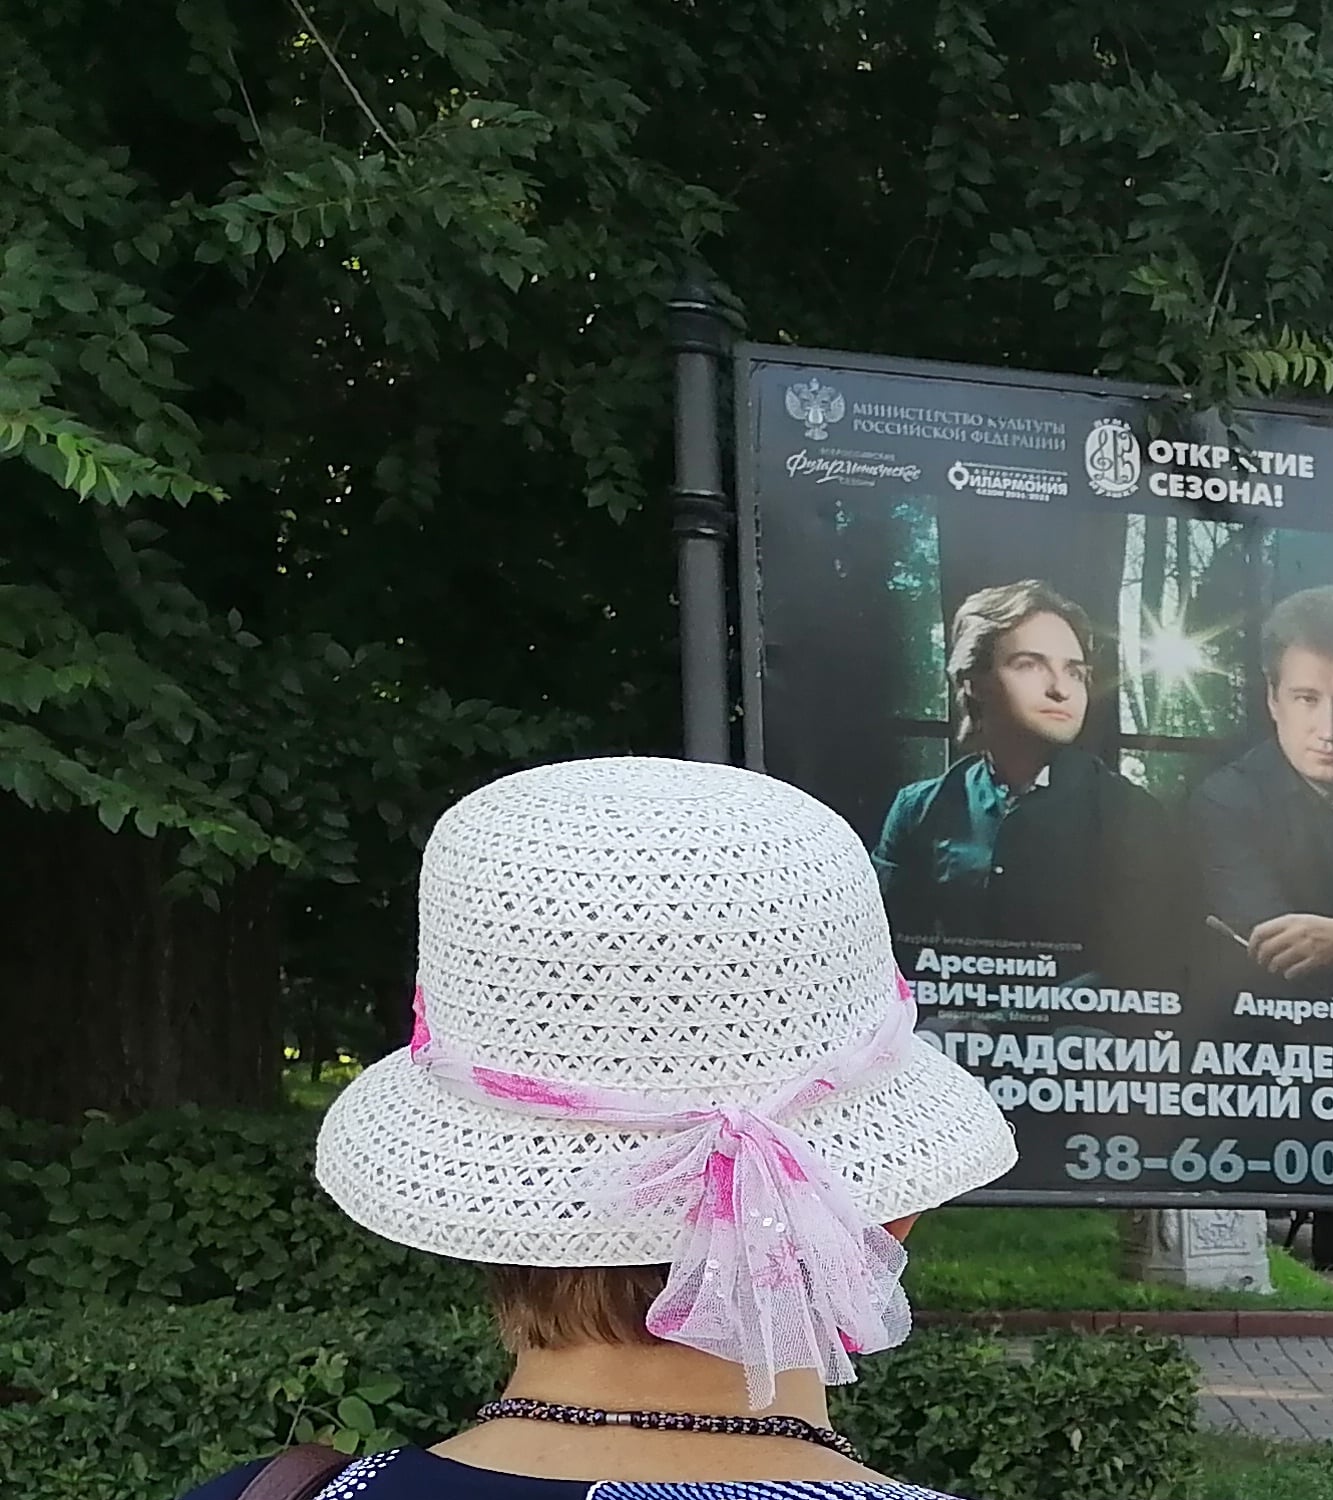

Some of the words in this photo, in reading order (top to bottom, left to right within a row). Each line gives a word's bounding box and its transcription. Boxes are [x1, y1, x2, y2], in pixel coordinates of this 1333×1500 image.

[853, 402, 983, 426] МИНИСТЕРСТВО
[987, 417, 1066, 434] КУЛЬТУРЫ
[853, 419, 966, 442] РОССИЙСКОЙ
[970, 430, 1066, 451] ФЕДЕРАЦИИ
[1149, 471, 1284, 508] СЕЗОНА!
[915, 947, 1058, 980] Арсений
[908, 980, 1183, 1015] ВИЧ-НИКОЛАЕВ
